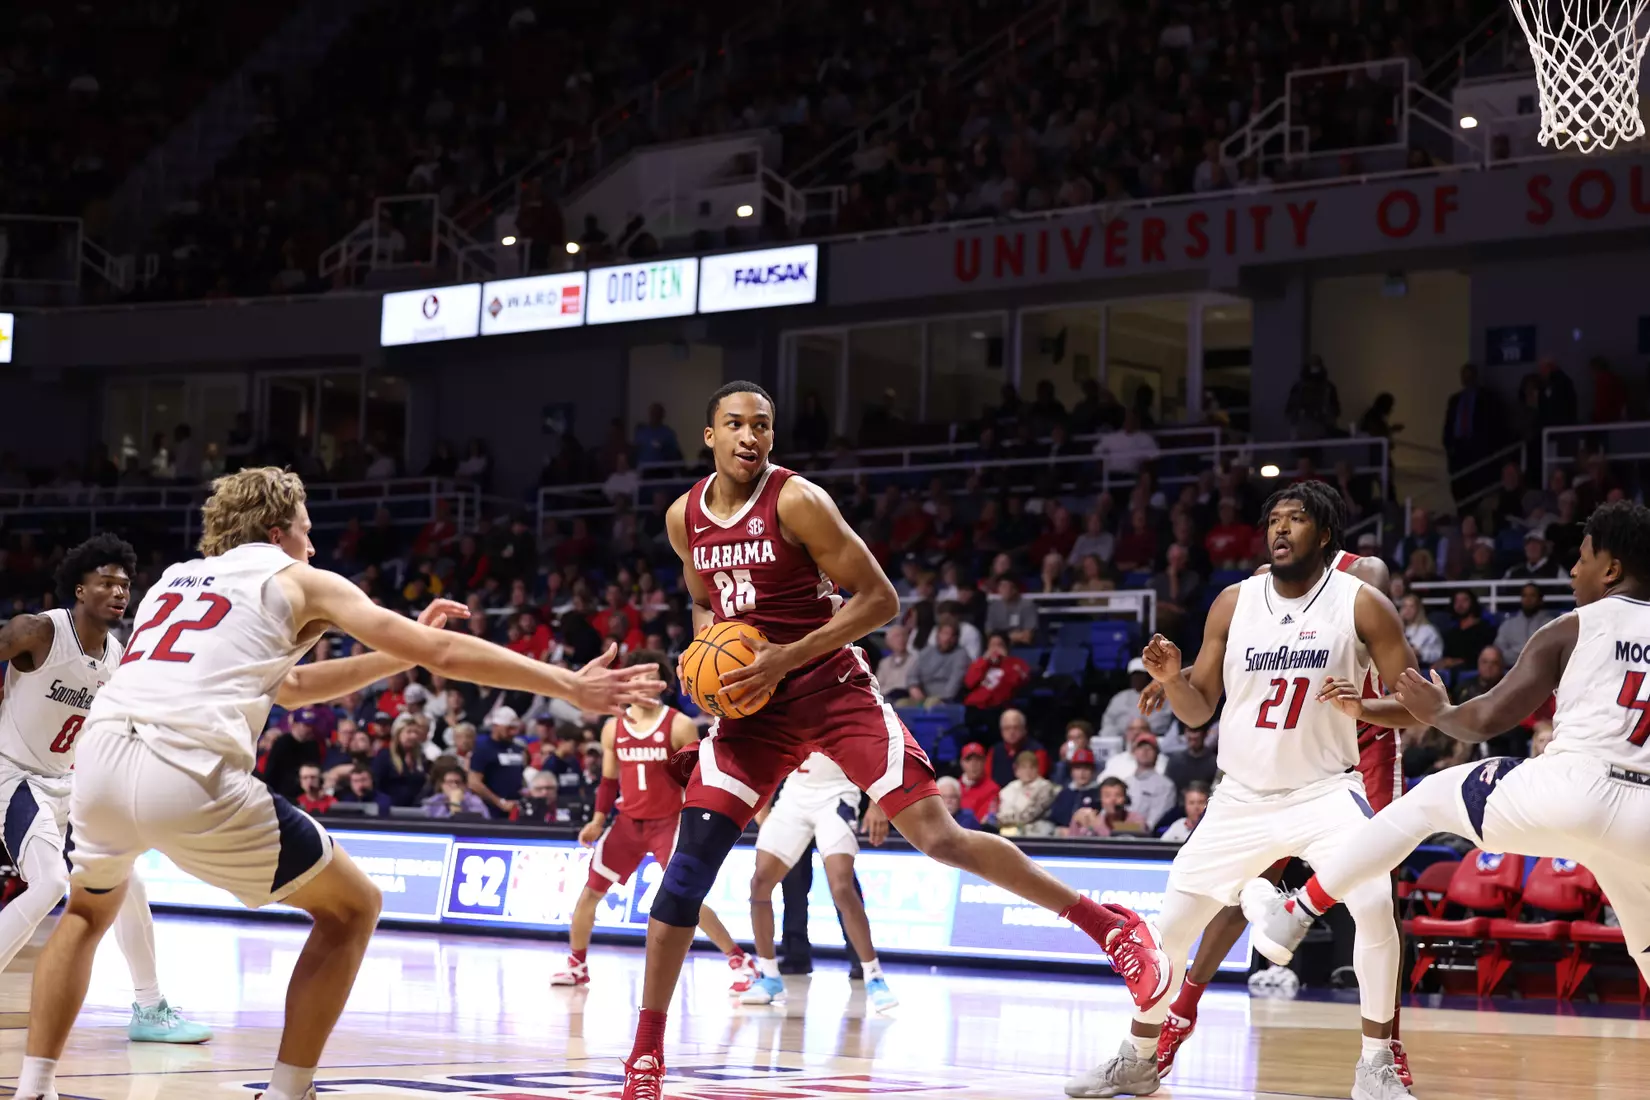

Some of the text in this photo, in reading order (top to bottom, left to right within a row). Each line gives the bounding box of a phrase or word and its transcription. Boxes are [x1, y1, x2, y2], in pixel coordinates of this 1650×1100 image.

[954, 200, 1318, 282] UNIVERSITY
[1377, 185, 1460, 237] OF
[693, 540, 776, 570] ALABAMA
[713, 569, 756, 618] 25
[119, 592, 232, 666] 22
[1255, 677, 1310, 730] 21
[1617, 670, 1650, 747] 4
[49, 714, 86, 753] 0
[637, 763, 647, 791] 1
[457, 855, 506, 907] 32
